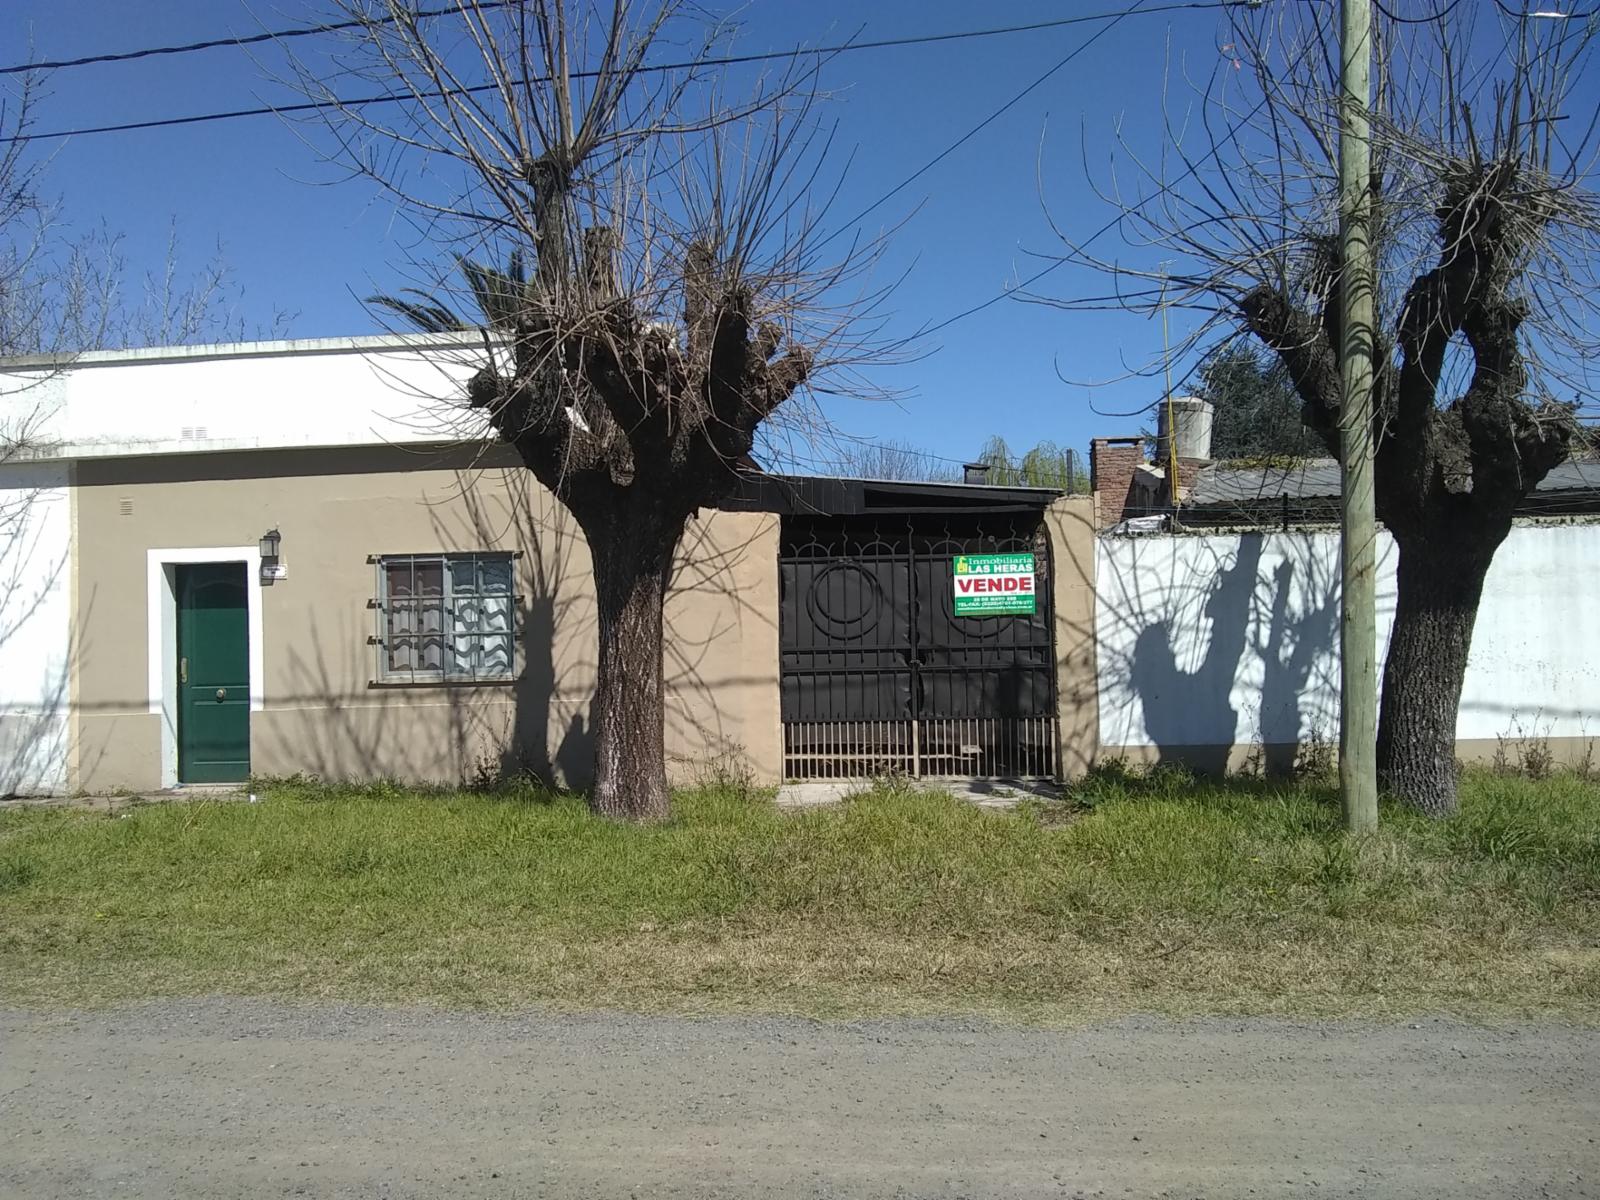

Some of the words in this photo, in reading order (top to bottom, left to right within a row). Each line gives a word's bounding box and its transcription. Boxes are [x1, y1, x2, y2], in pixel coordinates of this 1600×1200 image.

[968, 556, 1032, 565] Inmobiliaria
[968, 565, 990, 574] LAS
[993, 563, 1033, 573] HERAS
[957, 577, 1032, 593] VENDE
